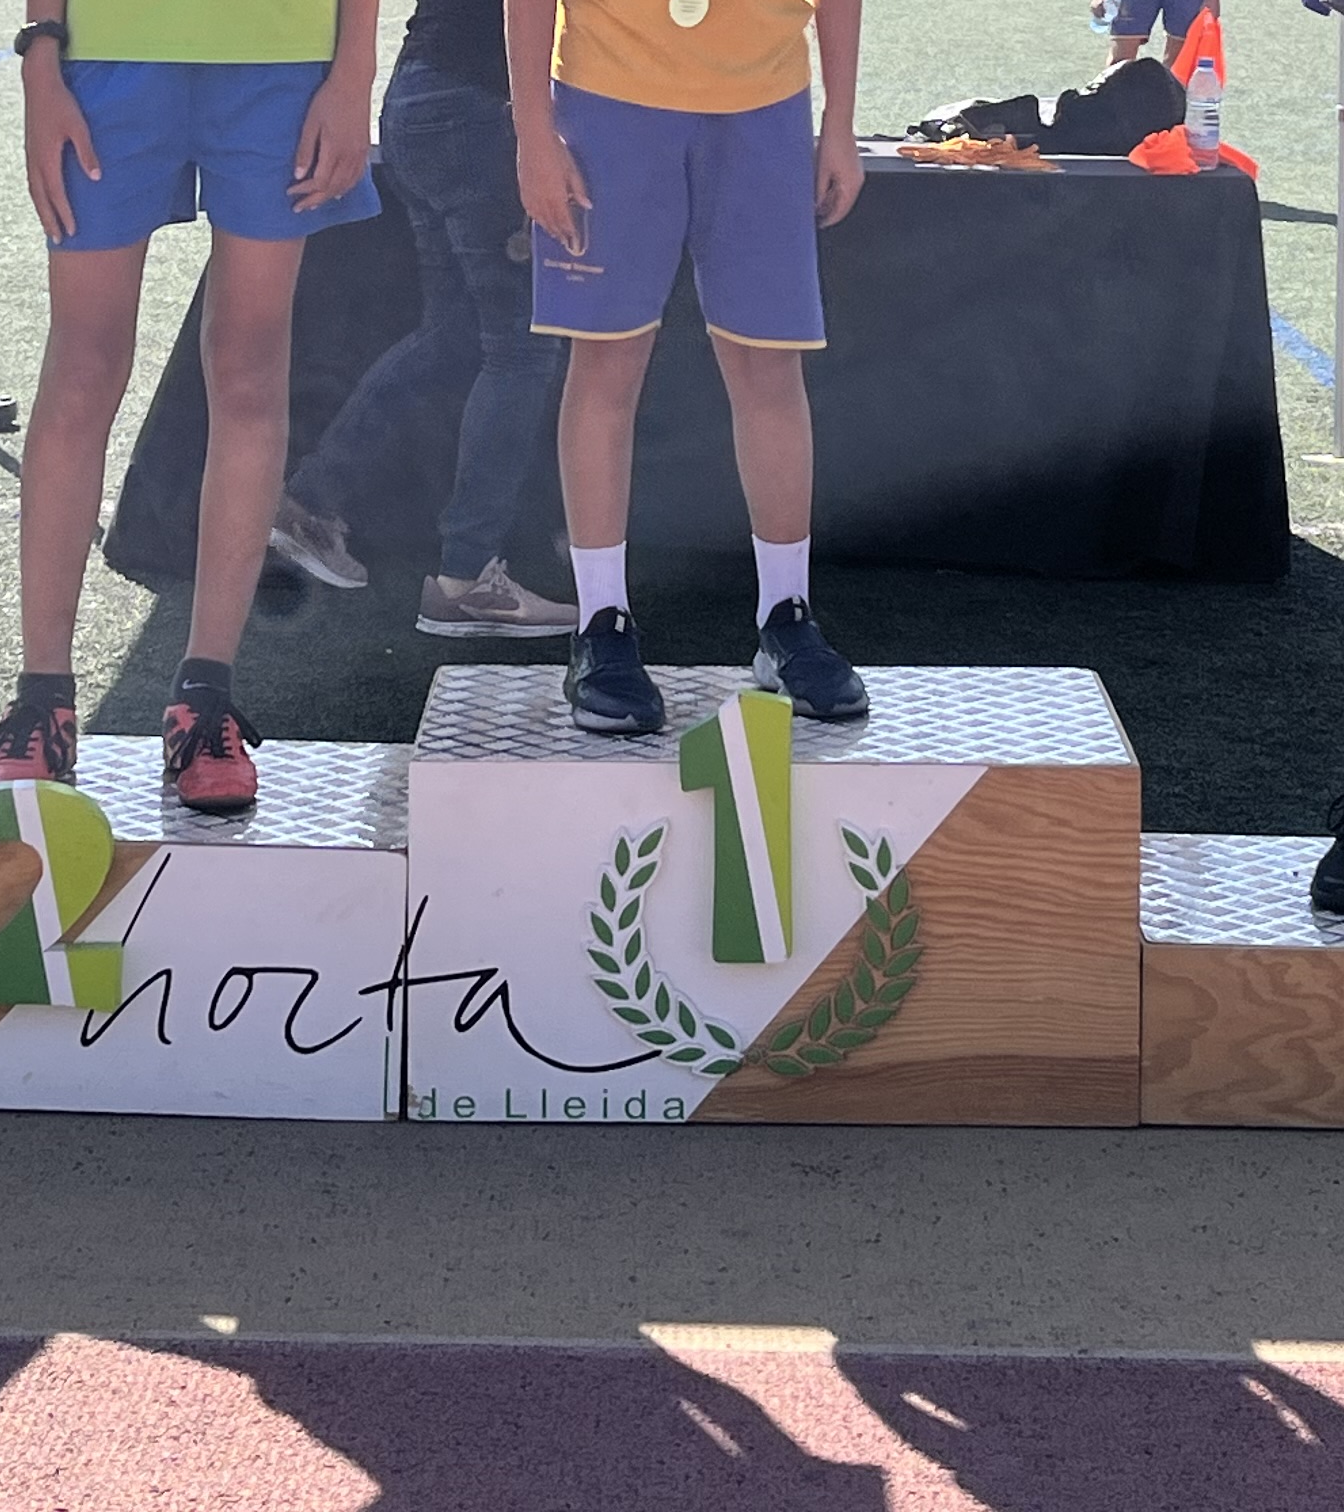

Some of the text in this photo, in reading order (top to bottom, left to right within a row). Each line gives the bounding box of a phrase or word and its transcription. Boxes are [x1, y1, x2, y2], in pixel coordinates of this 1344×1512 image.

[679, 690, 793, 965] 1
[417, 1088, 685, 1119] de Lleida
